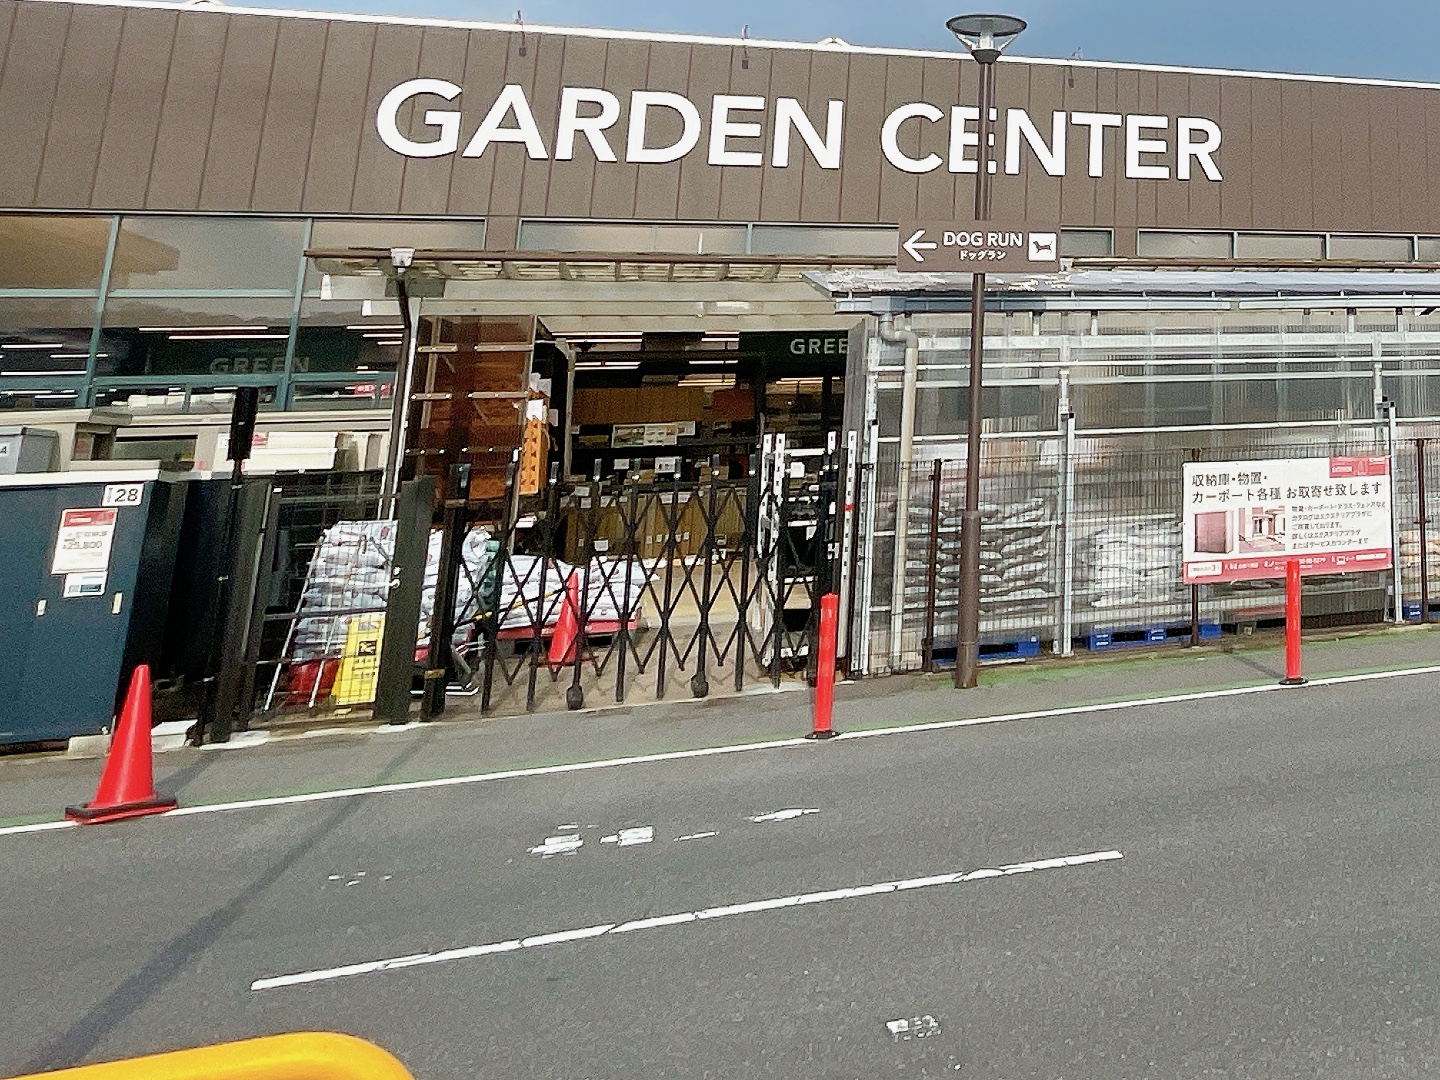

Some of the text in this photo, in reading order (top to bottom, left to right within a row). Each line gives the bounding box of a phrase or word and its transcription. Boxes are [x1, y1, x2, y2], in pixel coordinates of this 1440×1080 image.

[376, 77, 1224, 183] GARDEN CENTER
[942, 231, 1023, 247] DOG RUN
[959, 250, 1007, 261] ドッグラン
[114, 488, 139, 502] 28
[1192, 482, 1382, 503] カーポート各種 お取寄せ致します
